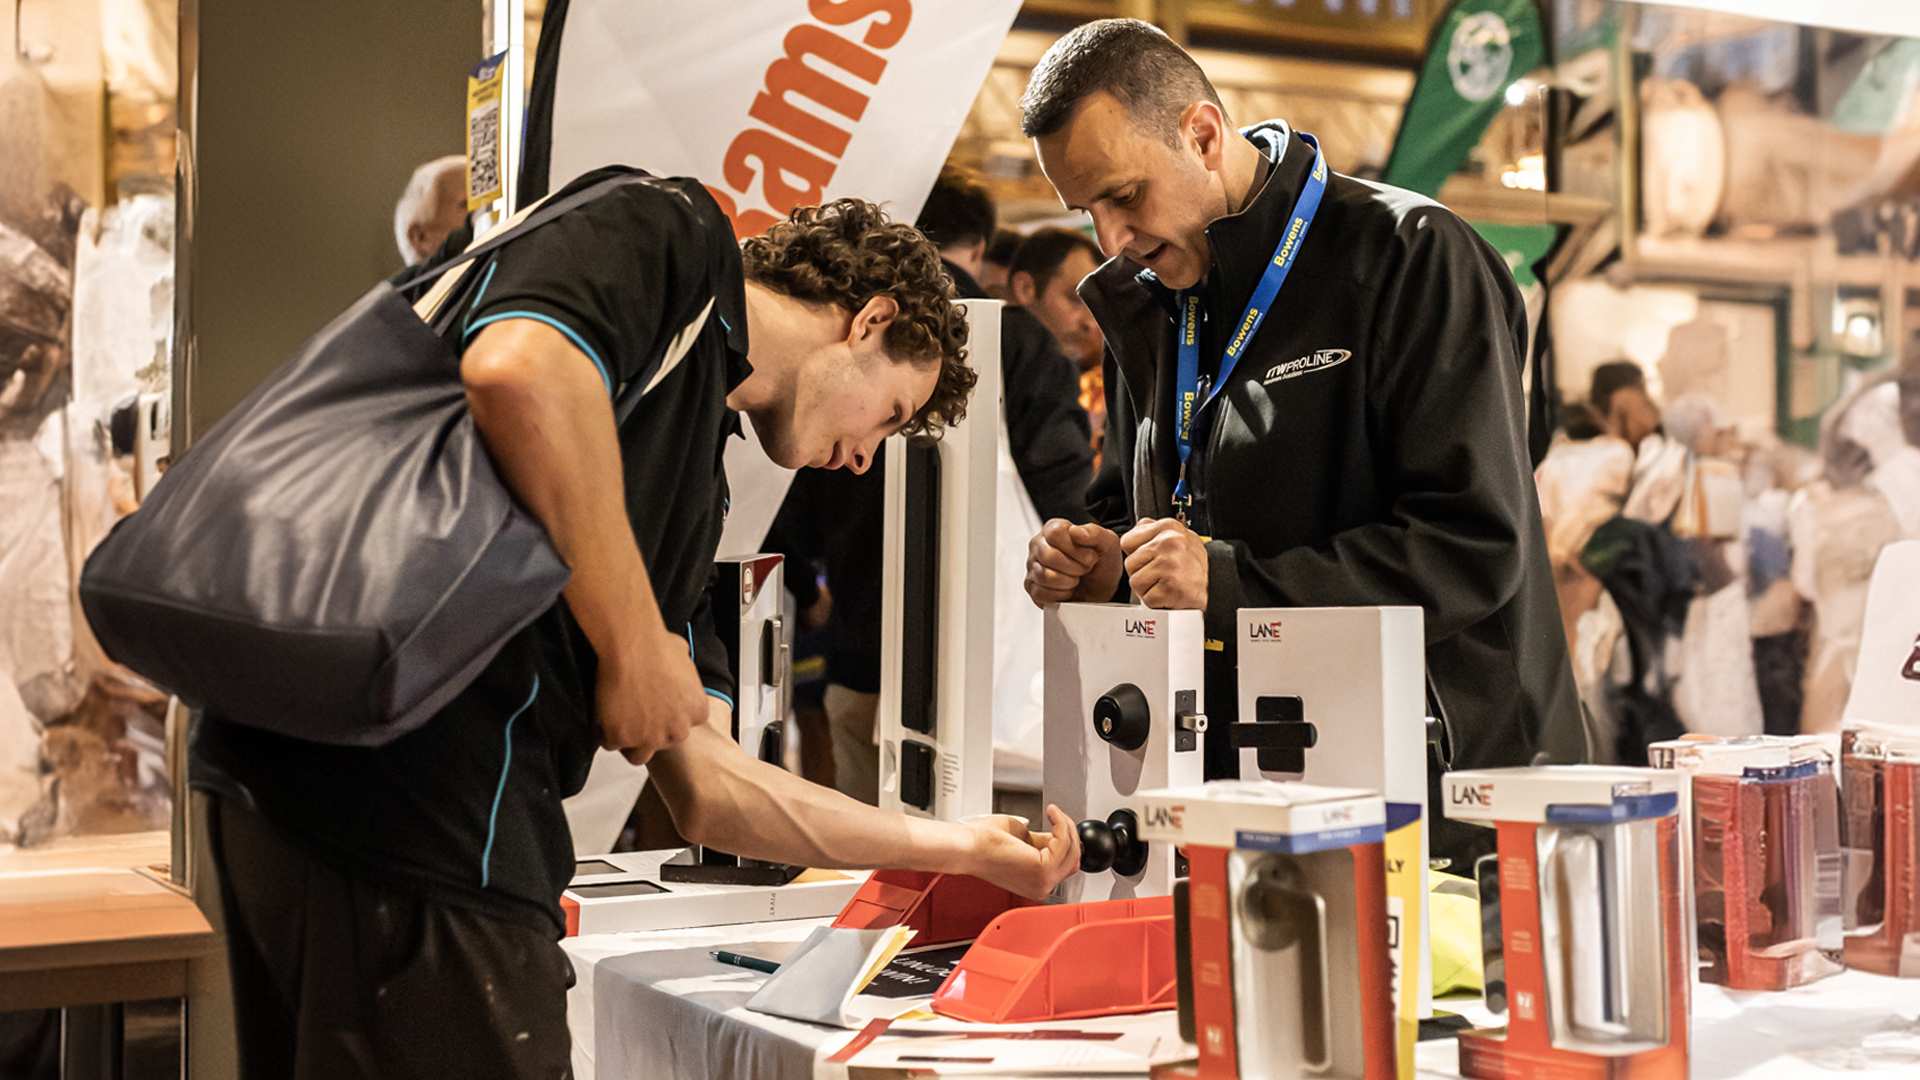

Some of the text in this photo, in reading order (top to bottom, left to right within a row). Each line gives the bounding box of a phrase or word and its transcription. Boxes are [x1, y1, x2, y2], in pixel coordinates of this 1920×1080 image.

[1273, 217, 1303, 267] Bowens
[1186, 295, 1199, 346] Bowens
[1226, 307, 1258, 357] Bowens
[1125, 619, 1156, 635] LANE
[1250, 621, 1282, 638] LANE
[1452, 783, 1494, 806] LANE
[1143, 805, 1185, 829] LANE
